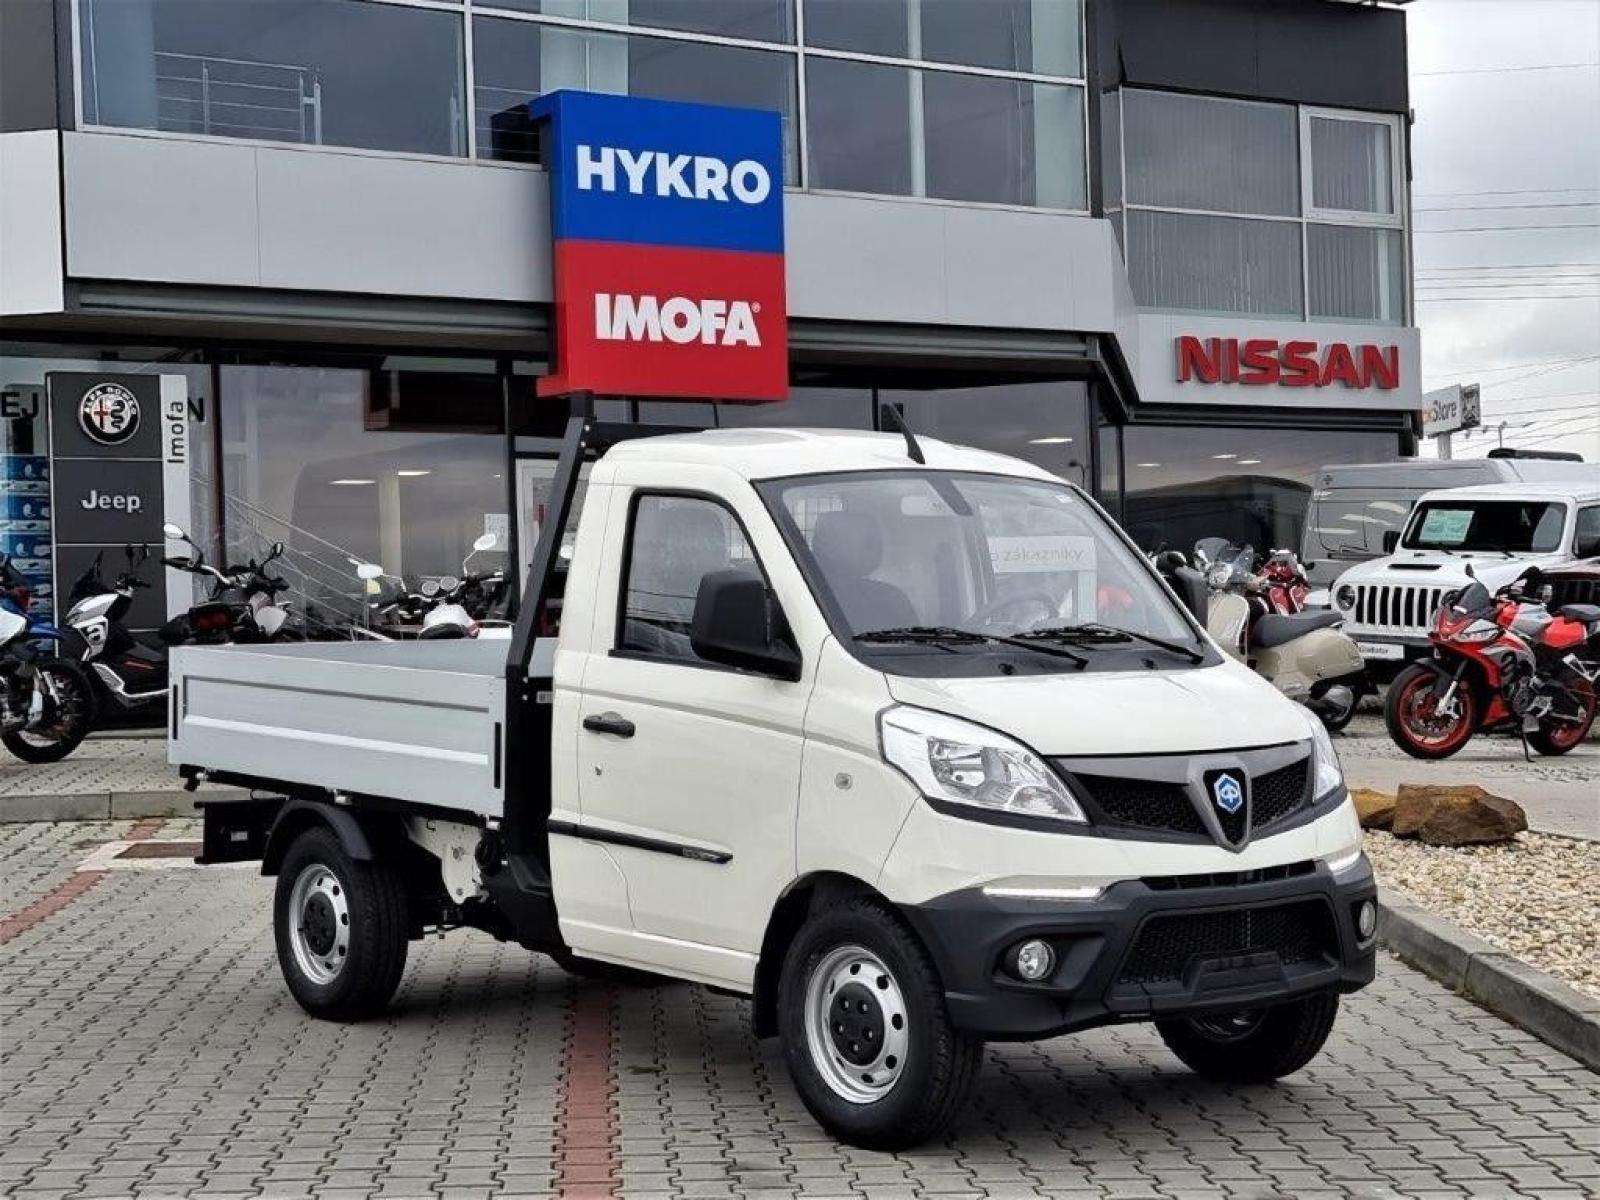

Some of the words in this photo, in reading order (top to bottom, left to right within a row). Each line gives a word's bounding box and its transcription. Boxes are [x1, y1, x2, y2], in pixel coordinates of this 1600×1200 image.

[576, 144, 771, 204] HYKRO
[1175, 335, 1399, 390] NISSAN
[167, 401, 184, 463] Imofa
[81, 490, 141, 513] Jeep
